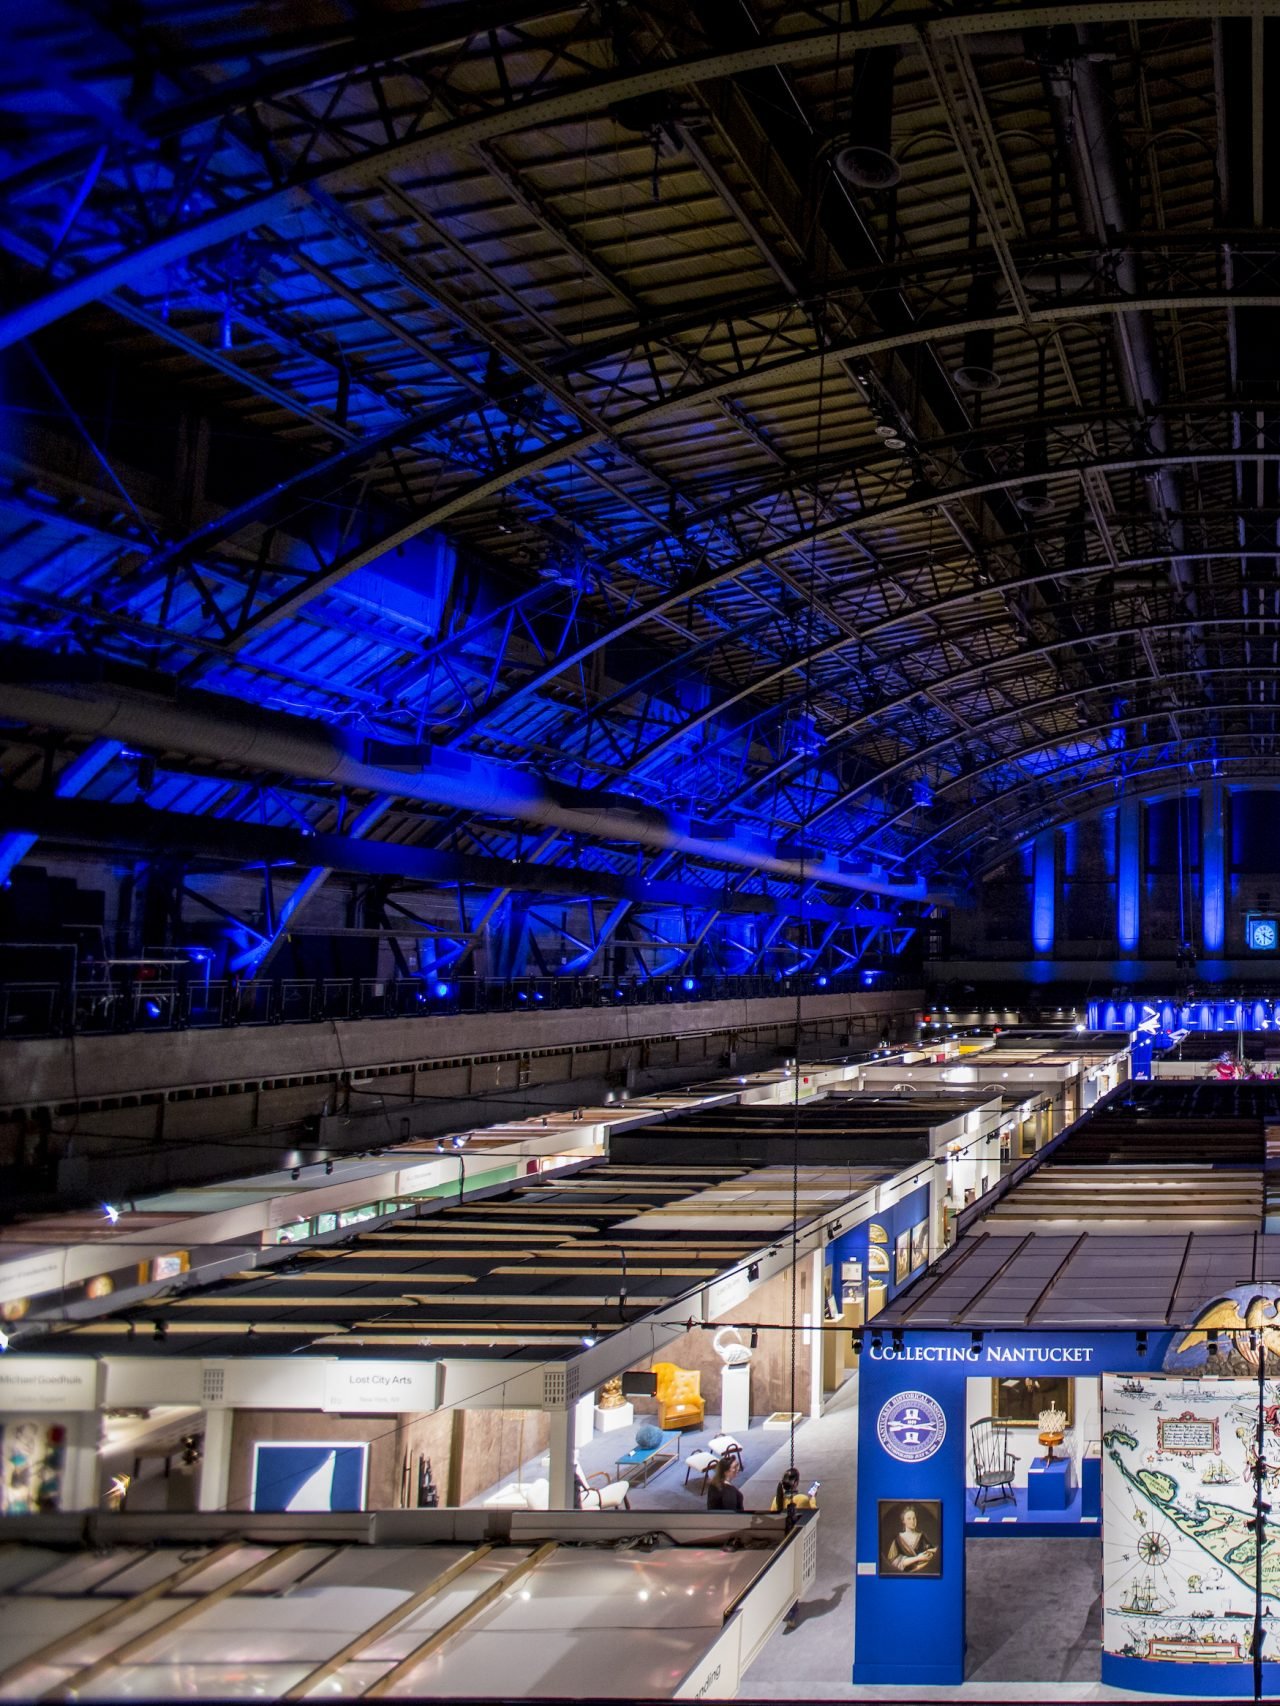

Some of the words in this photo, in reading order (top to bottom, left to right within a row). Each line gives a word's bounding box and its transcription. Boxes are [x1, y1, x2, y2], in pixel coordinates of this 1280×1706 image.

[869, 1347, 979, 1361] COLLECTING
[987, 1347, 1093, 1361] NANTUCKET
[349, 1375, 370, 1384] Lost
[372, 1375, 391, 1386] City
[392, 1375, 412, 1384] Arts
